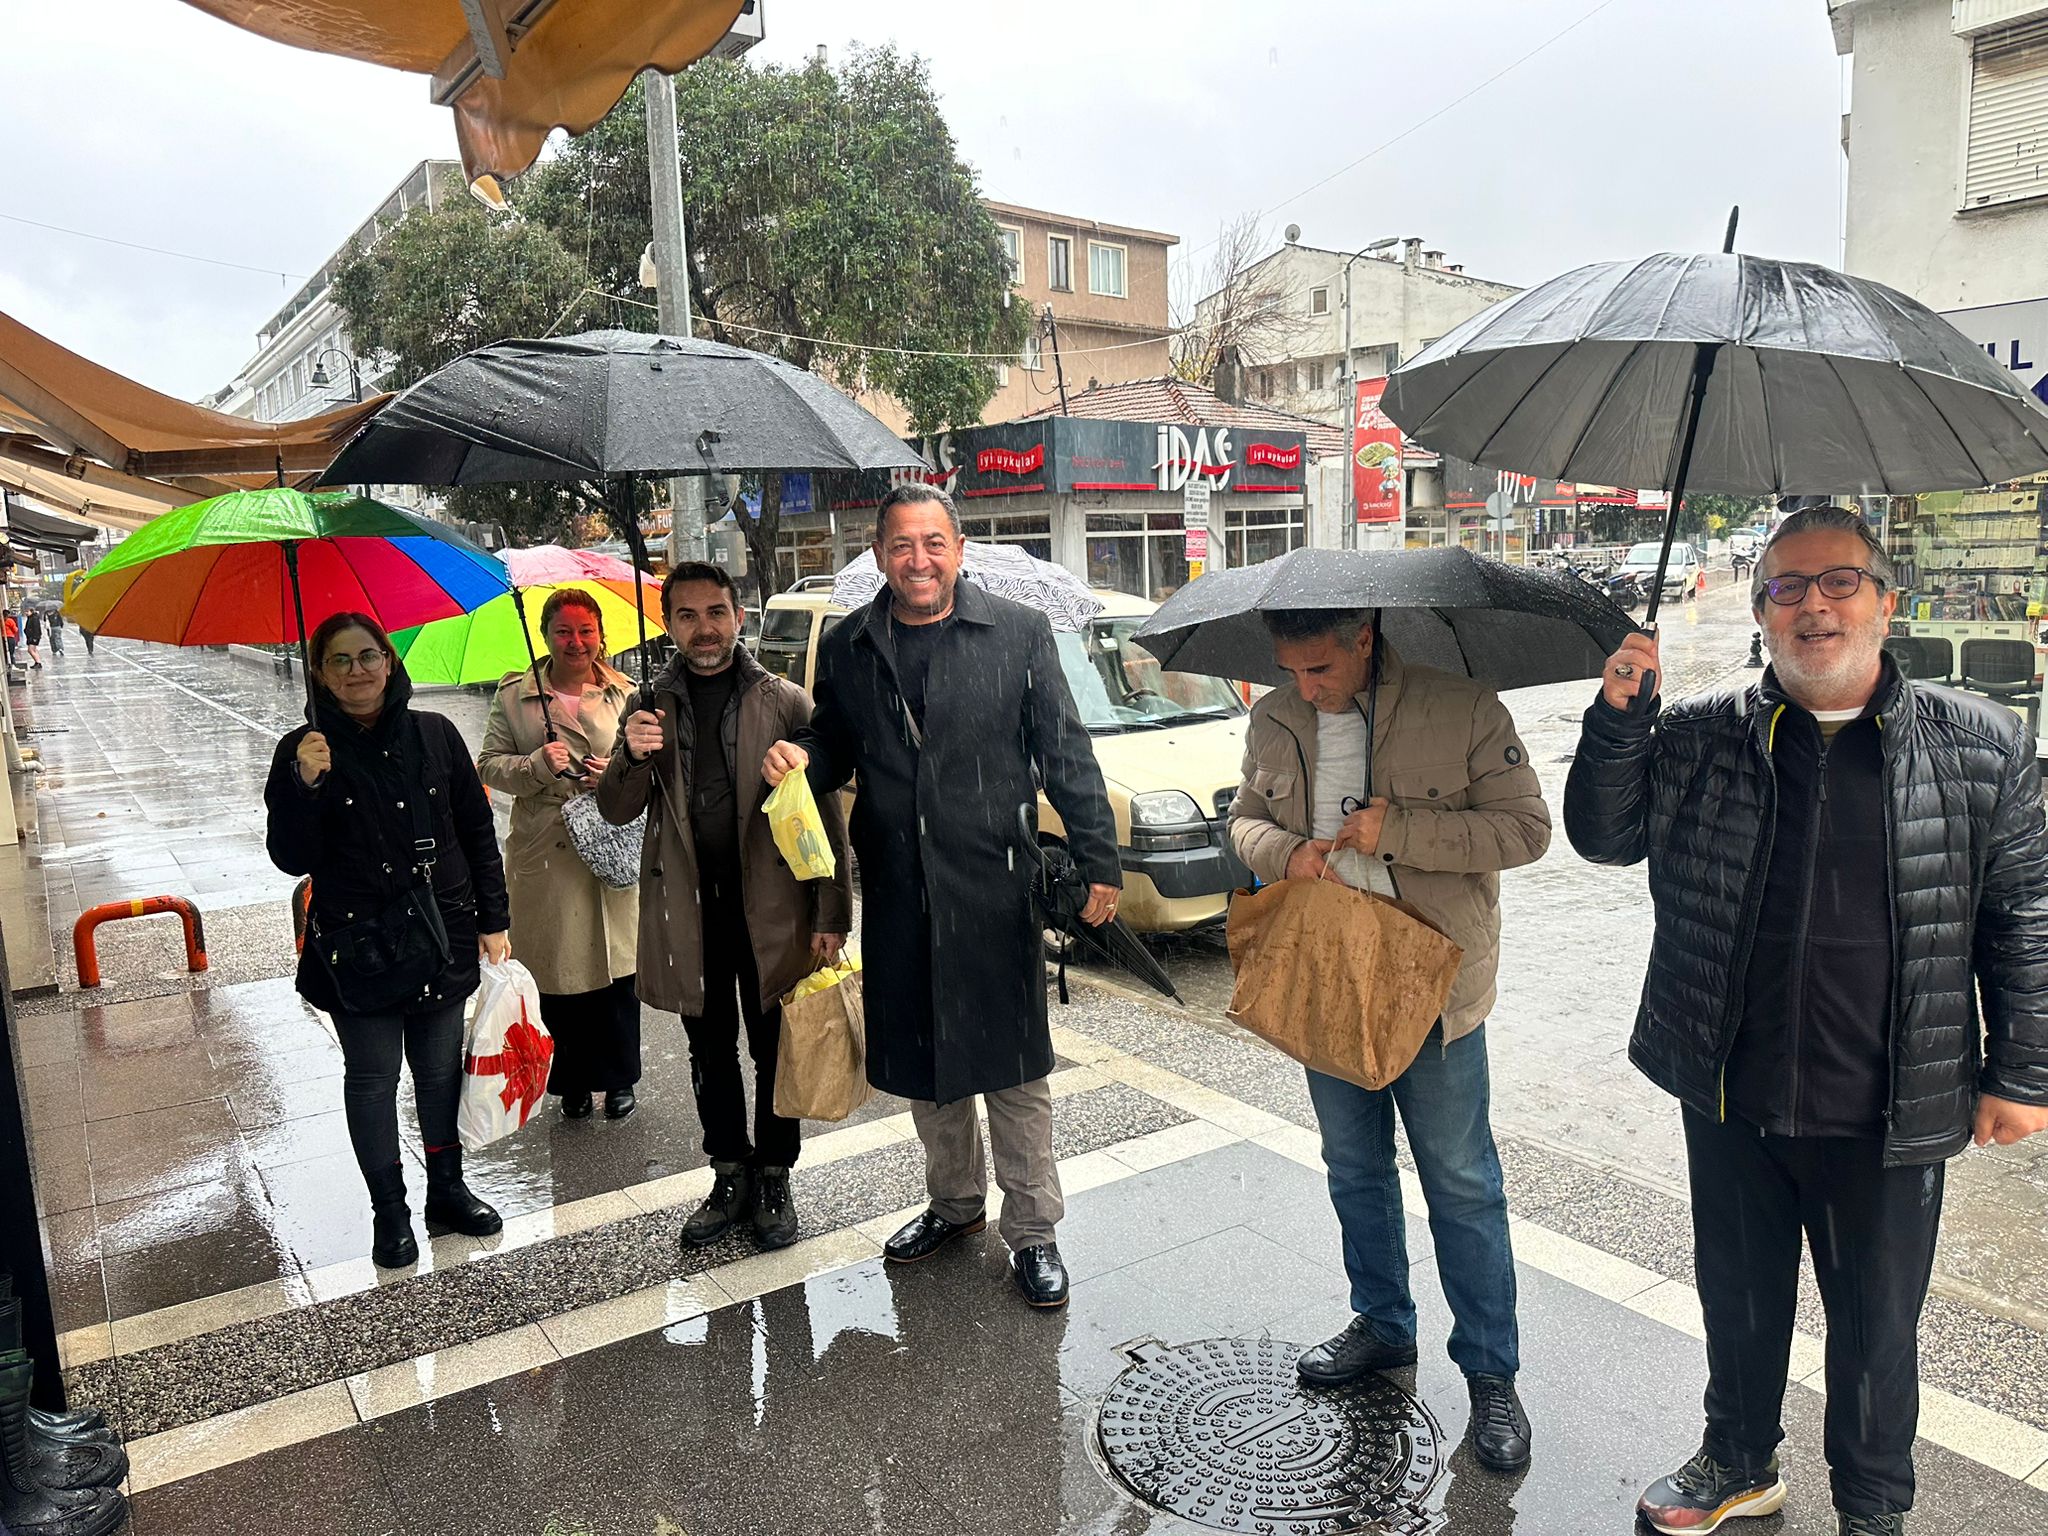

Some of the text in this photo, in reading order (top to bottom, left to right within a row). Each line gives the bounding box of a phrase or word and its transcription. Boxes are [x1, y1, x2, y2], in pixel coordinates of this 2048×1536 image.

[979, 454, 1036, 469] iyi uykular
[1253, 450, 1297, 464] iyi uykular
